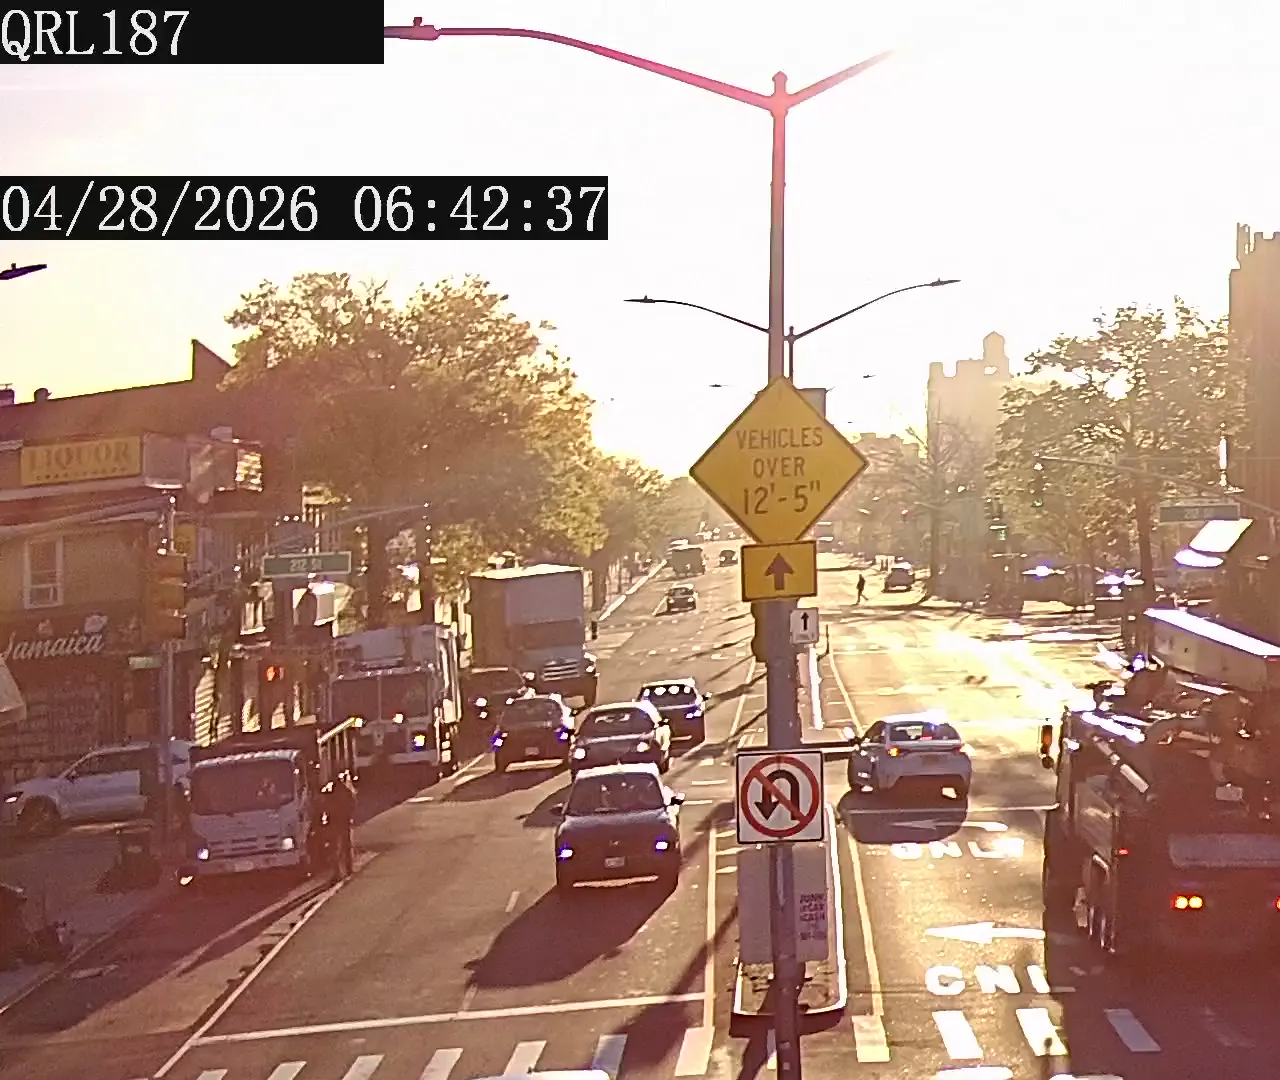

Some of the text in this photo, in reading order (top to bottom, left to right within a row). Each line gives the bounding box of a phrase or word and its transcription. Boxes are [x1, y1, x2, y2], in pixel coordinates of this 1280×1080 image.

[736, 427, 823, 450] VEHICLES
[28, 443, 133, 474] LIQUOR
[752, 456, 806, 478] OVER
